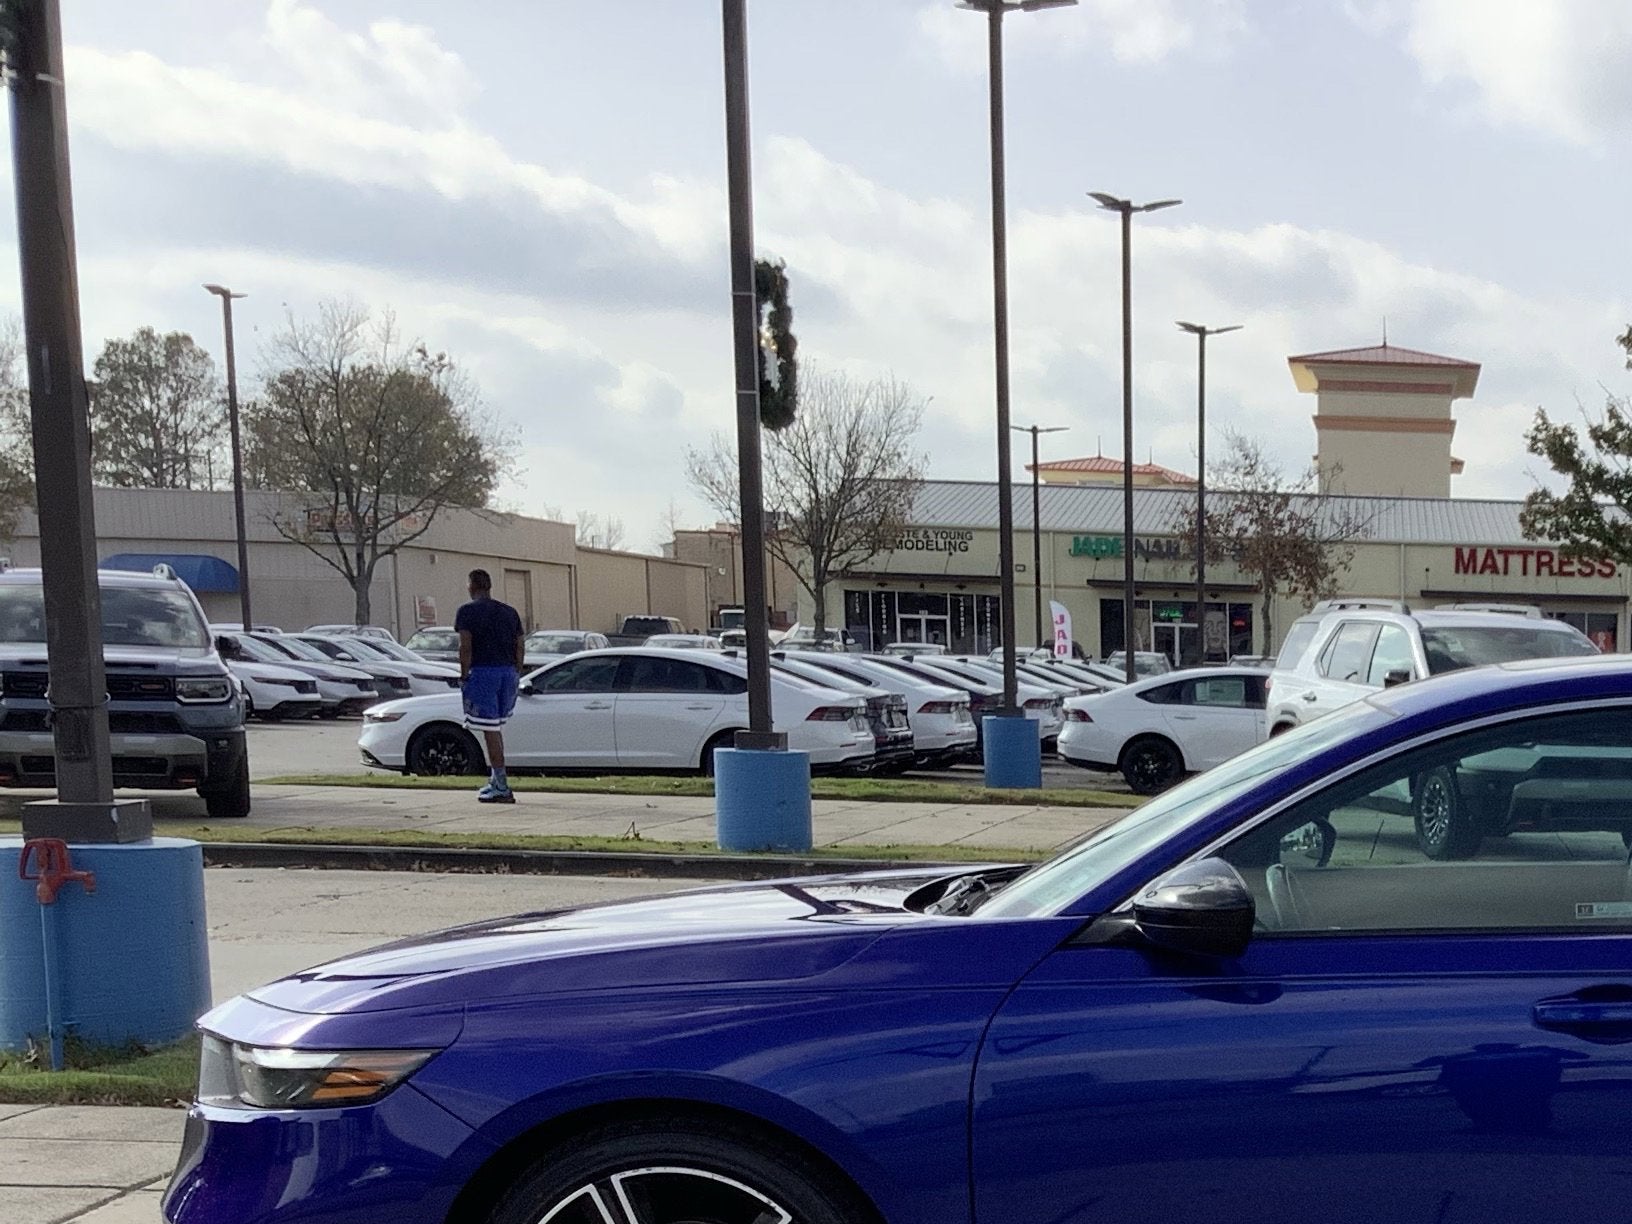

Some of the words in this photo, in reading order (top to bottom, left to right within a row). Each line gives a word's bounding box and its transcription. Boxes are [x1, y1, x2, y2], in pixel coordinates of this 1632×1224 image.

[922, 528, 930, 539] &
[933, 529, 973, 541] YOUNG
[1068, 536, 1125, 558] JADE
[1454, 547, 1616, 579] MATTRESS
